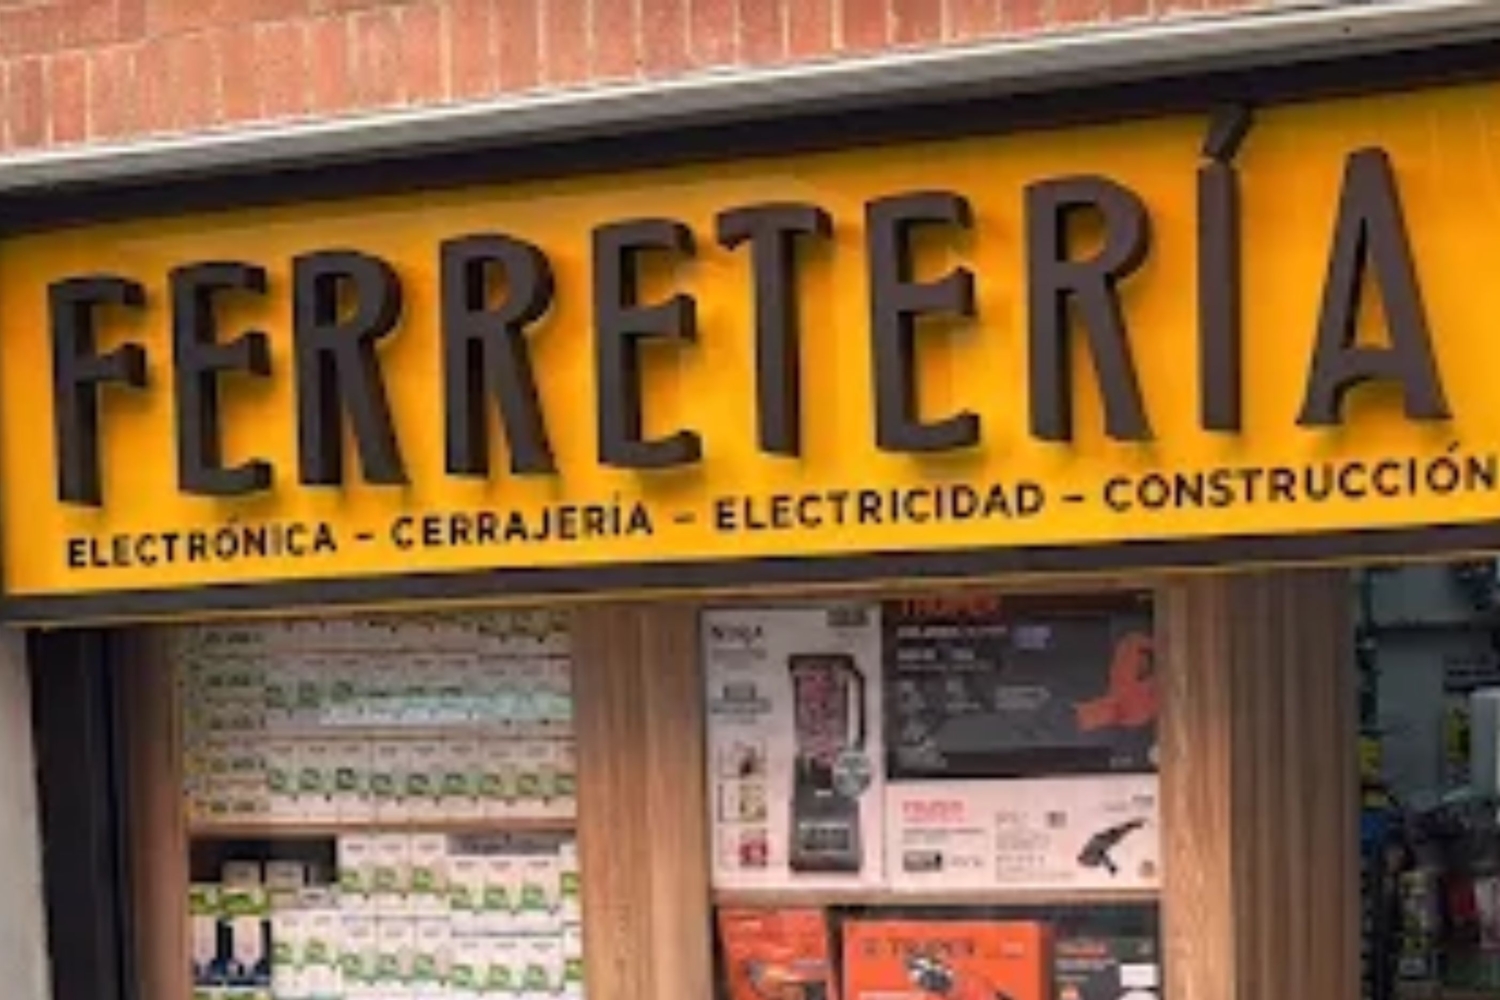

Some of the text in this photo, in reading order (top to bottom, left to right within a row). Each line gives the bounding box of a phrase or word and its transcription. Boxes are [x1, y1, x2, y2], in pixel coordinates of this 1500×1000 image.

[46, 104, 1453, 508] FERRETERÍA
[66, 515, 338, 569] ELECTRÓNICA
[390, 491, 655, 549] CERRAJERÍA
[714, 482, 1045, 532] ELECTRICIDAD
[1102, 440, 1498, 513] CONSTRUCCIÓN
